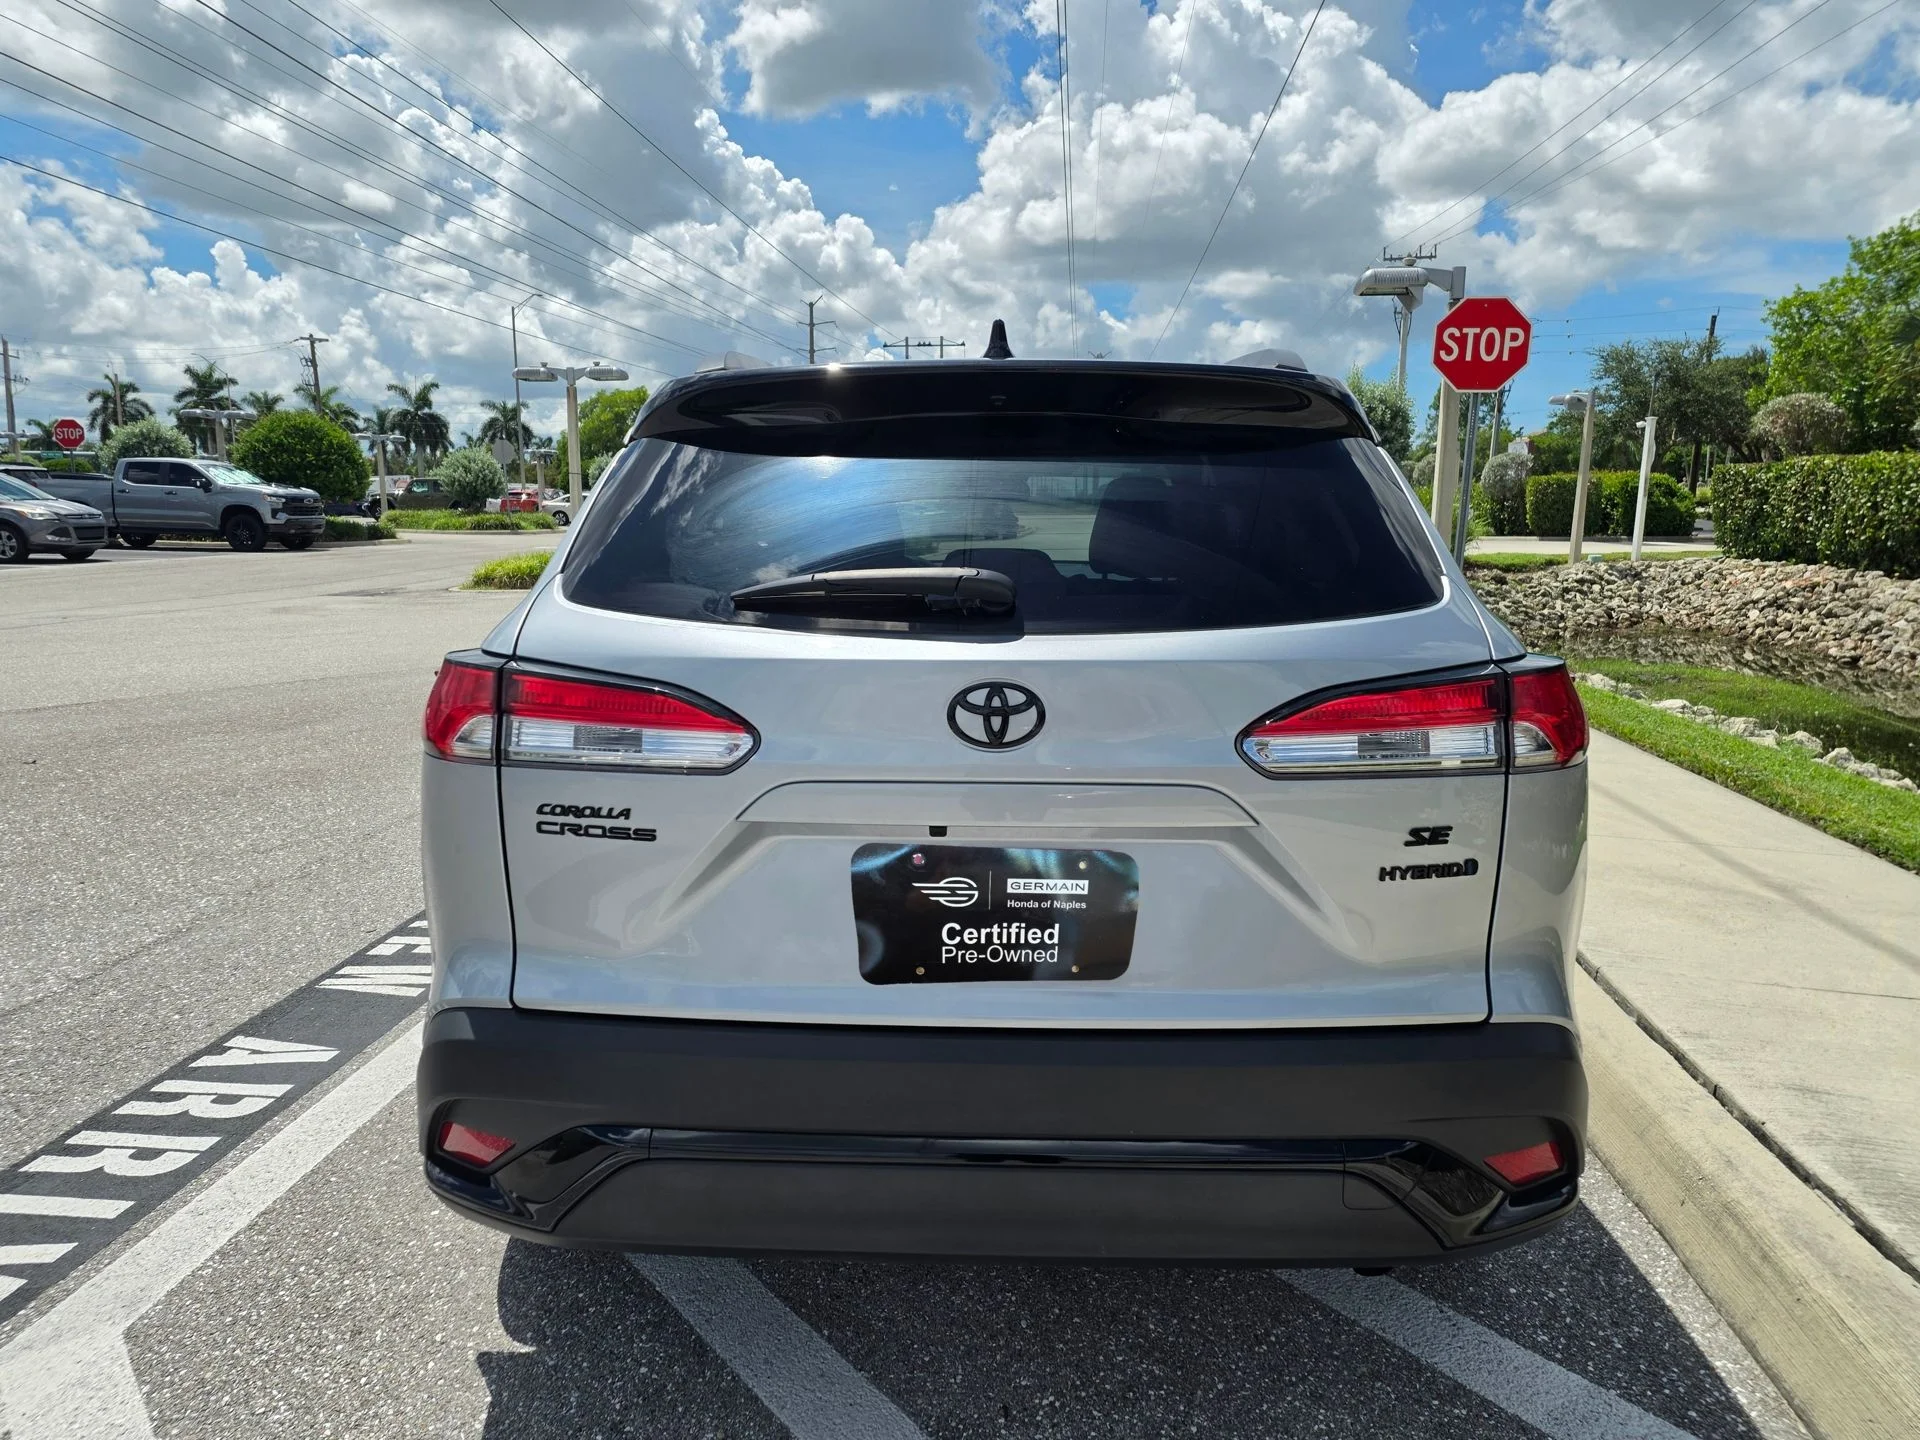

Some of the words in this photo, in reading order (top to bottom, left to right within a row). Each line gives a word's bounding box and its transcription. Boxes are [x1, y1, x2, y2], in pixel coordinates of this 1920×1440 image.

[1439, 326, 1525, 362] STOP
[56, 427, 83, 439] STOP
[536, 803, 632, 820] COROLLA
[536, 820, 657, 842] CROSS
[1403, 825, 1453, 847] SE
[1379, 860, 1467, 881] HYBRID
[1010, 881, 1086, 892] GERMAIN
[1007, 899, 1039, 909] Honda
[1041, 899, 1052, 909] of
[1053, 899, 1087, 911] Naples
[941, 922, 1060, 945] Certified
[315, 920, 432, 997] EW
[941, 945, 1059, 964] Pre-Owned
